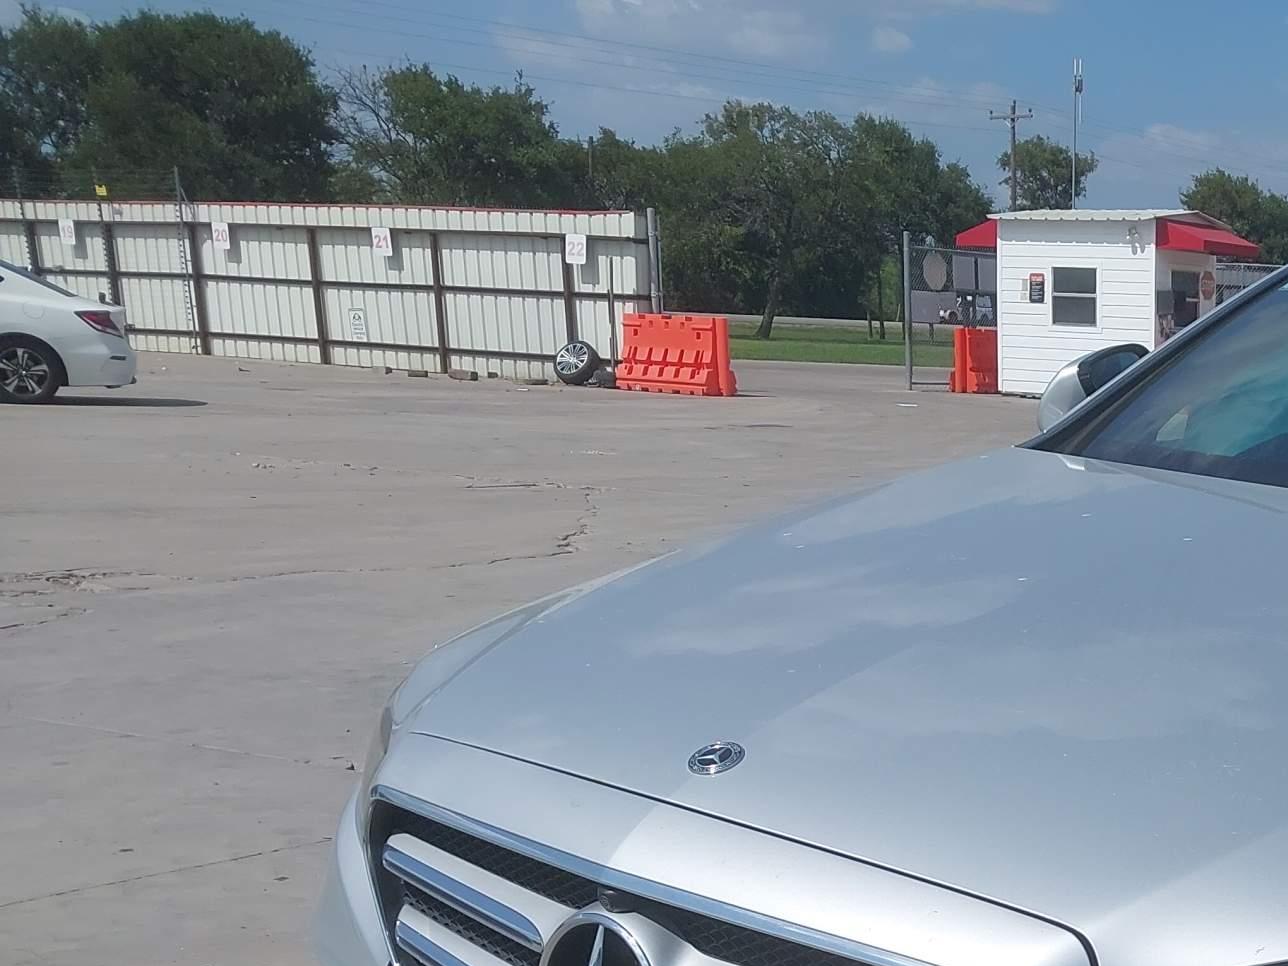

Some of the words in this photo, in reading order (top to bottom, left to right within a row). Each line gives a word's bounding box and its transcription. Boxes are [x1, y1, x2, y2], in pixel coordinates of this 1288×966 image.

[62, 225, 74, 236] 19
[213, 229, 228, 242] 20
[374, 235, 390, 249] 21
[567, 241, 585, 257] 22
